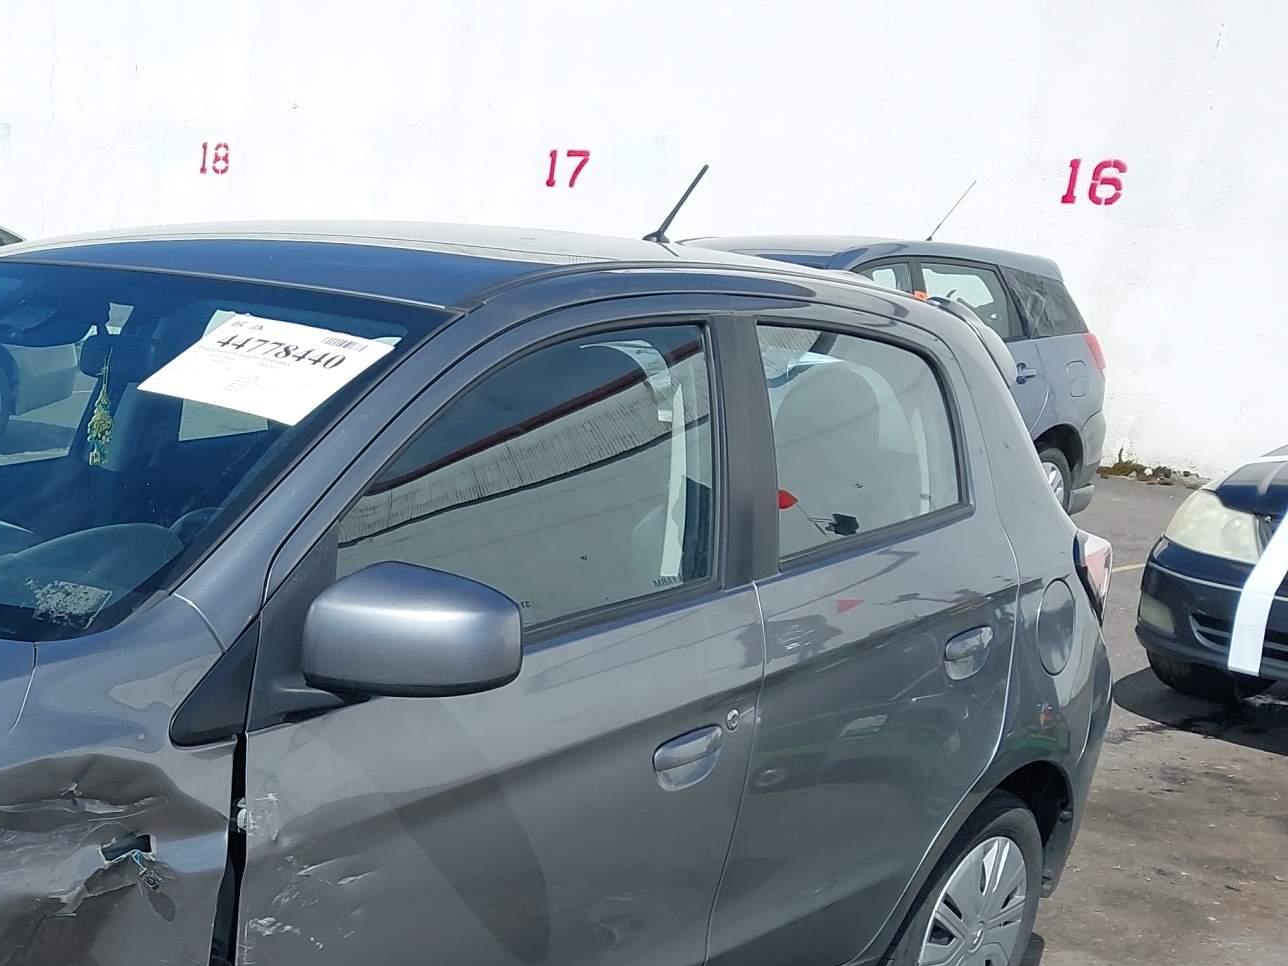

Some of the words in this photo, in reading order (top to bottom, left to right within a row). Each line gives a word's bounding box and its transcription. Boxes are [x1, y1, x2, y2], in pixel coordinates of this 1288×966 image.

[199, 141, 230, 175] 18
[545, 149, 591, 188] 17
[1060, 158, 1129, 206] 16
[216, 334, 347, 371] 44778440
